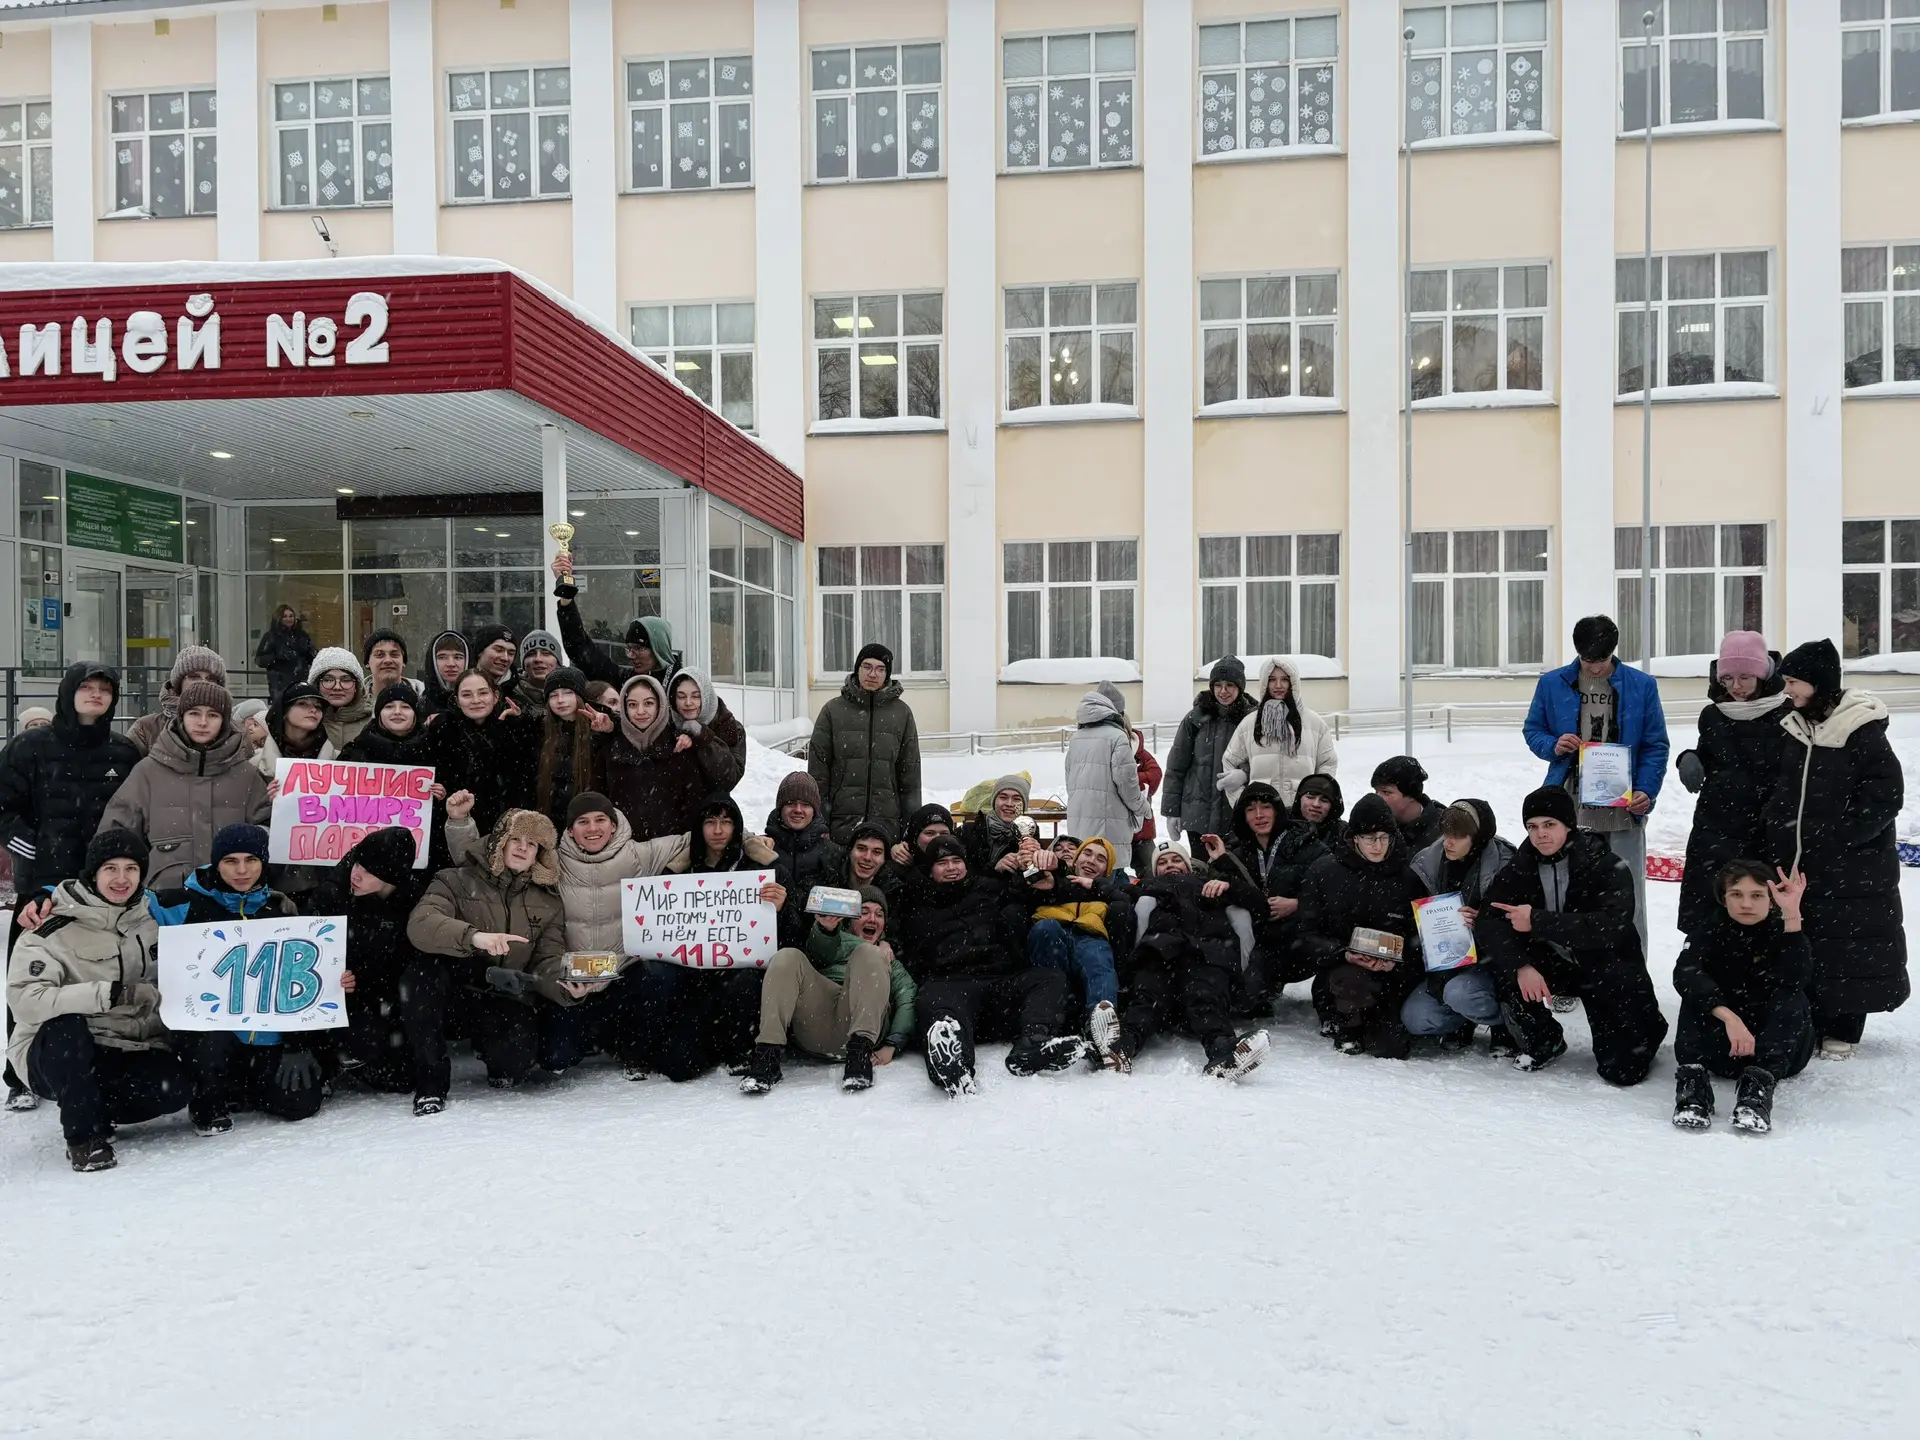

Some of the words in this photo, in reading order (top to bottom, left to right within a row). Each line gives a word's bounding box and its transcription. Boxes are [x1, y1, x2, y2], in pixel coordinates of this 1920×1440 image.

[523, 639, 556, 652] HUGO
[282, 763, 434, 800] ЛУЧШИЕ
[328, 795, 422, 827] МИРЕ
[684, 888, 762, 909] ПРЕКРАСЕН
[707, 926, 748, 943] ЕСТЬ
[213, 939, 323, 1015] 11В
